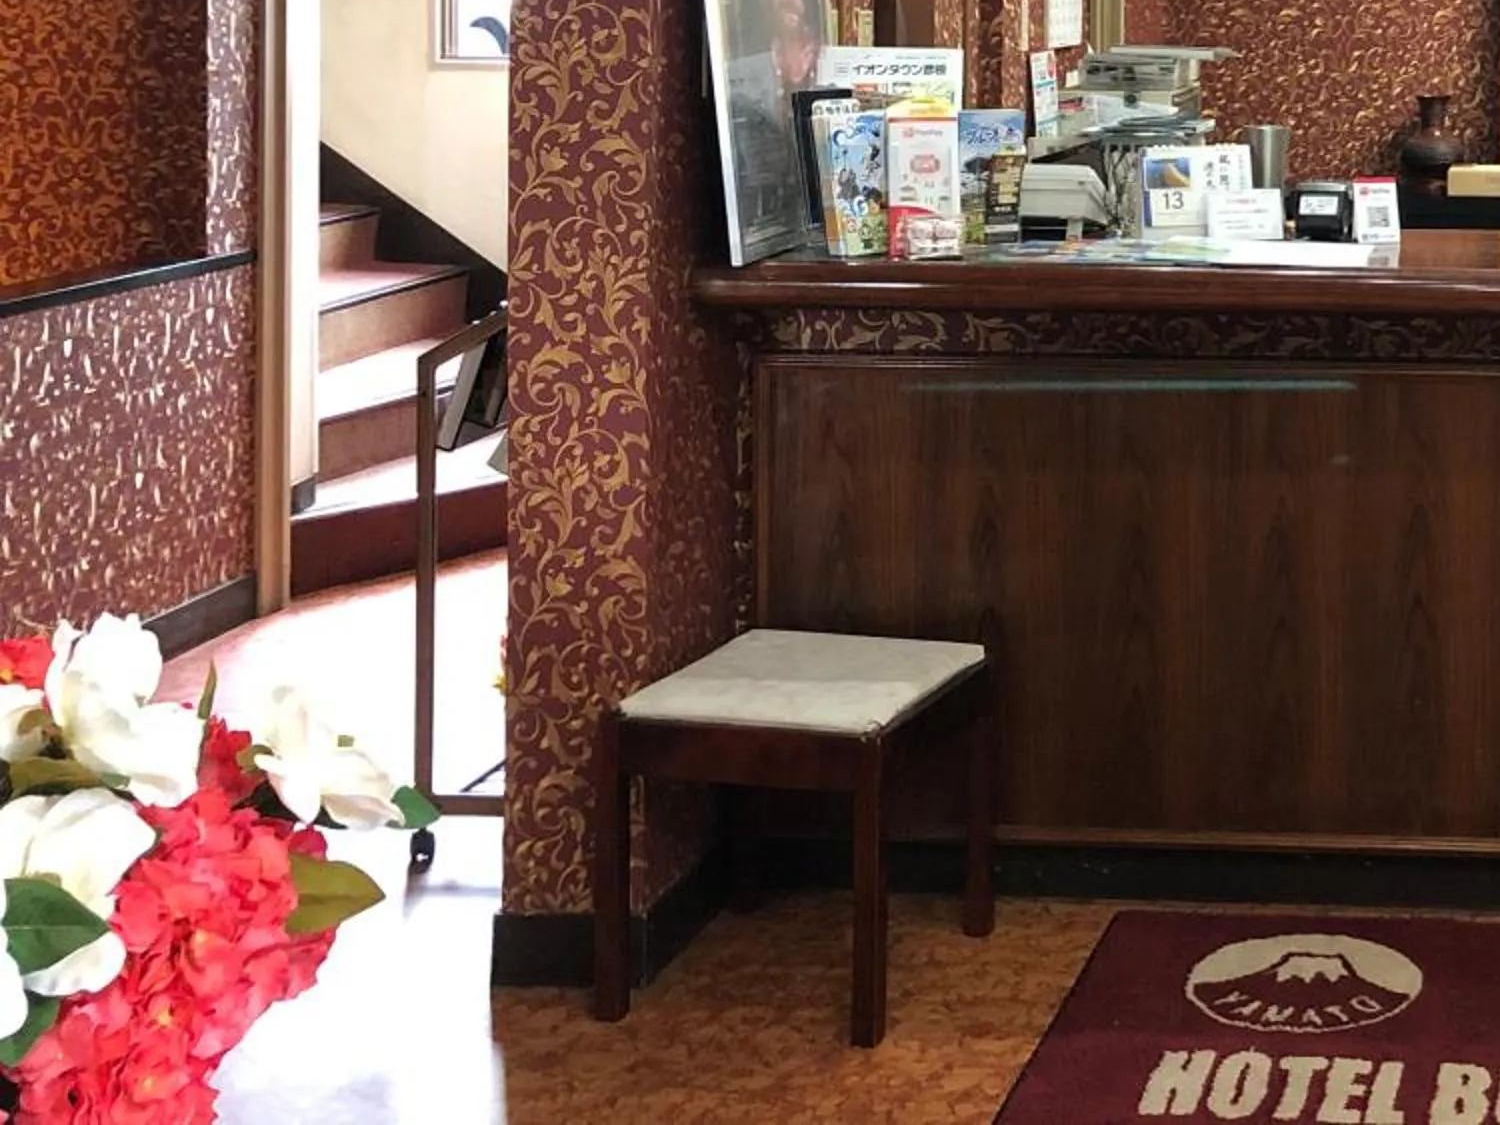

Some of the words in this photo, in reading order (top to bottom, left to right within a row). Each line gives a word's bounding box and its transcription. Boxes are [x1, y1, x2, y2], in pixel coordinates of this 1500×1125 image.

[1162, 190, 1185, 210] 13
[1213, 990, 1384, 1025] YAMATO
[1137, 1048, 1405, 1125] HOTEL
